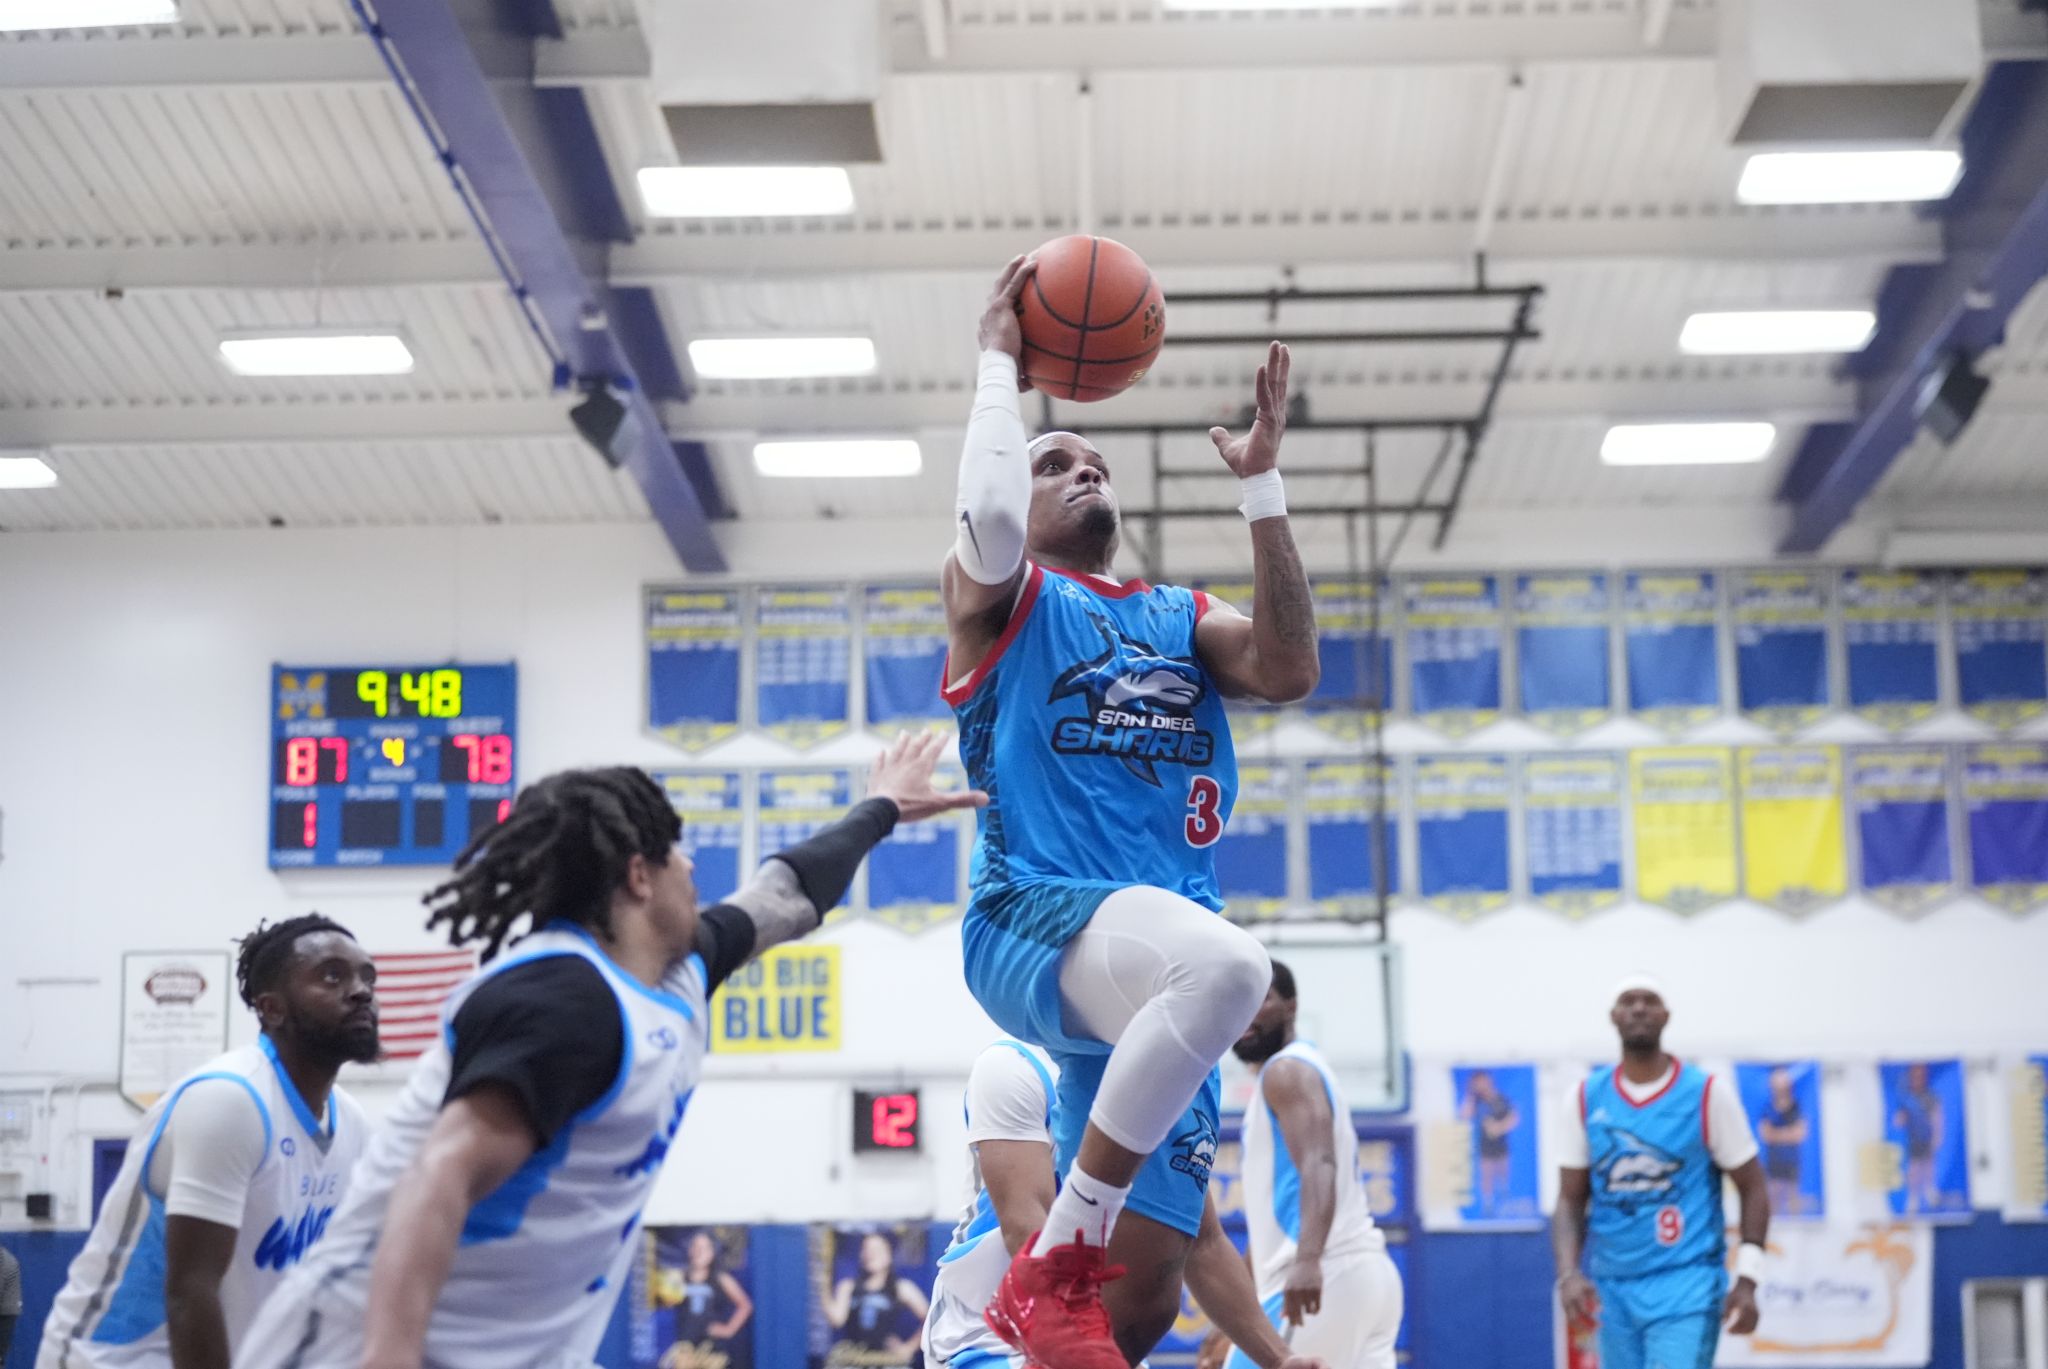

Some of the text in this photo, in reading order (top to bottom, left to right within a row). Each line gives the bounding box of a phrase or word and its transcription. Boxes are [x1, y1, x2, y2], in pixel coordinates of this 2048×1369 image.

[1096, 709, 1196, 733] SAN DIEG
[286, 736, 349, 786] 87
[453, 733, 513, 785] 78
[303, 802, 317, 847] 1
[1185, 775, 1224, 849] 3
[776, 957, 829, 988] BIG
[725, 995, 830, 1040] BLUE
[872, 1094, 917, 1147] 12
[300, 1173, 339, 1197] BLUE
[1655, 1204, 1685, 1248] 9
